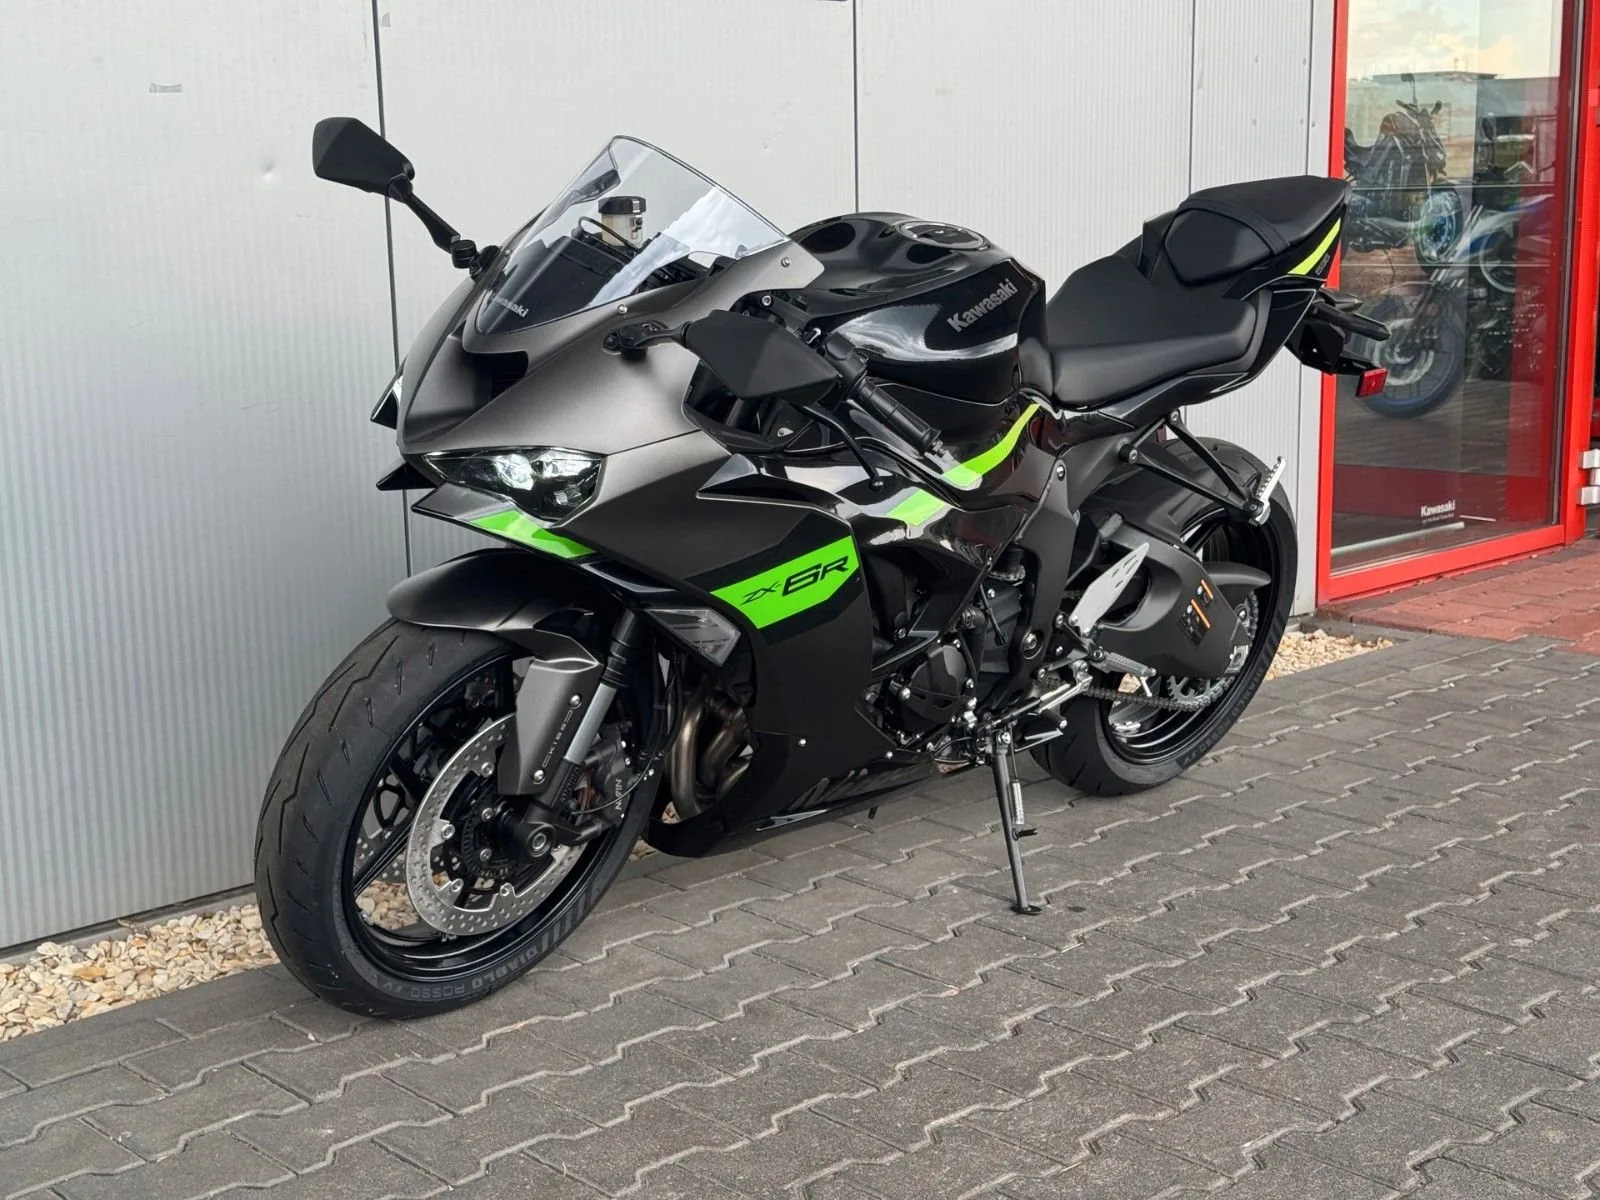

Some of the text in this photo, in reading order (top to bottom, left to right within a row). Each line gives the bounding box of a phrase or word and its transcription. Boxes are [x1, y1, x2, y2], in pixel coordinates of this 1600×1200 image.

[947, 278, 1018, 332] Kawasaki
[471, 946, 539, 989] DIABLO
[411, 984, 465, 998] ROSSO
